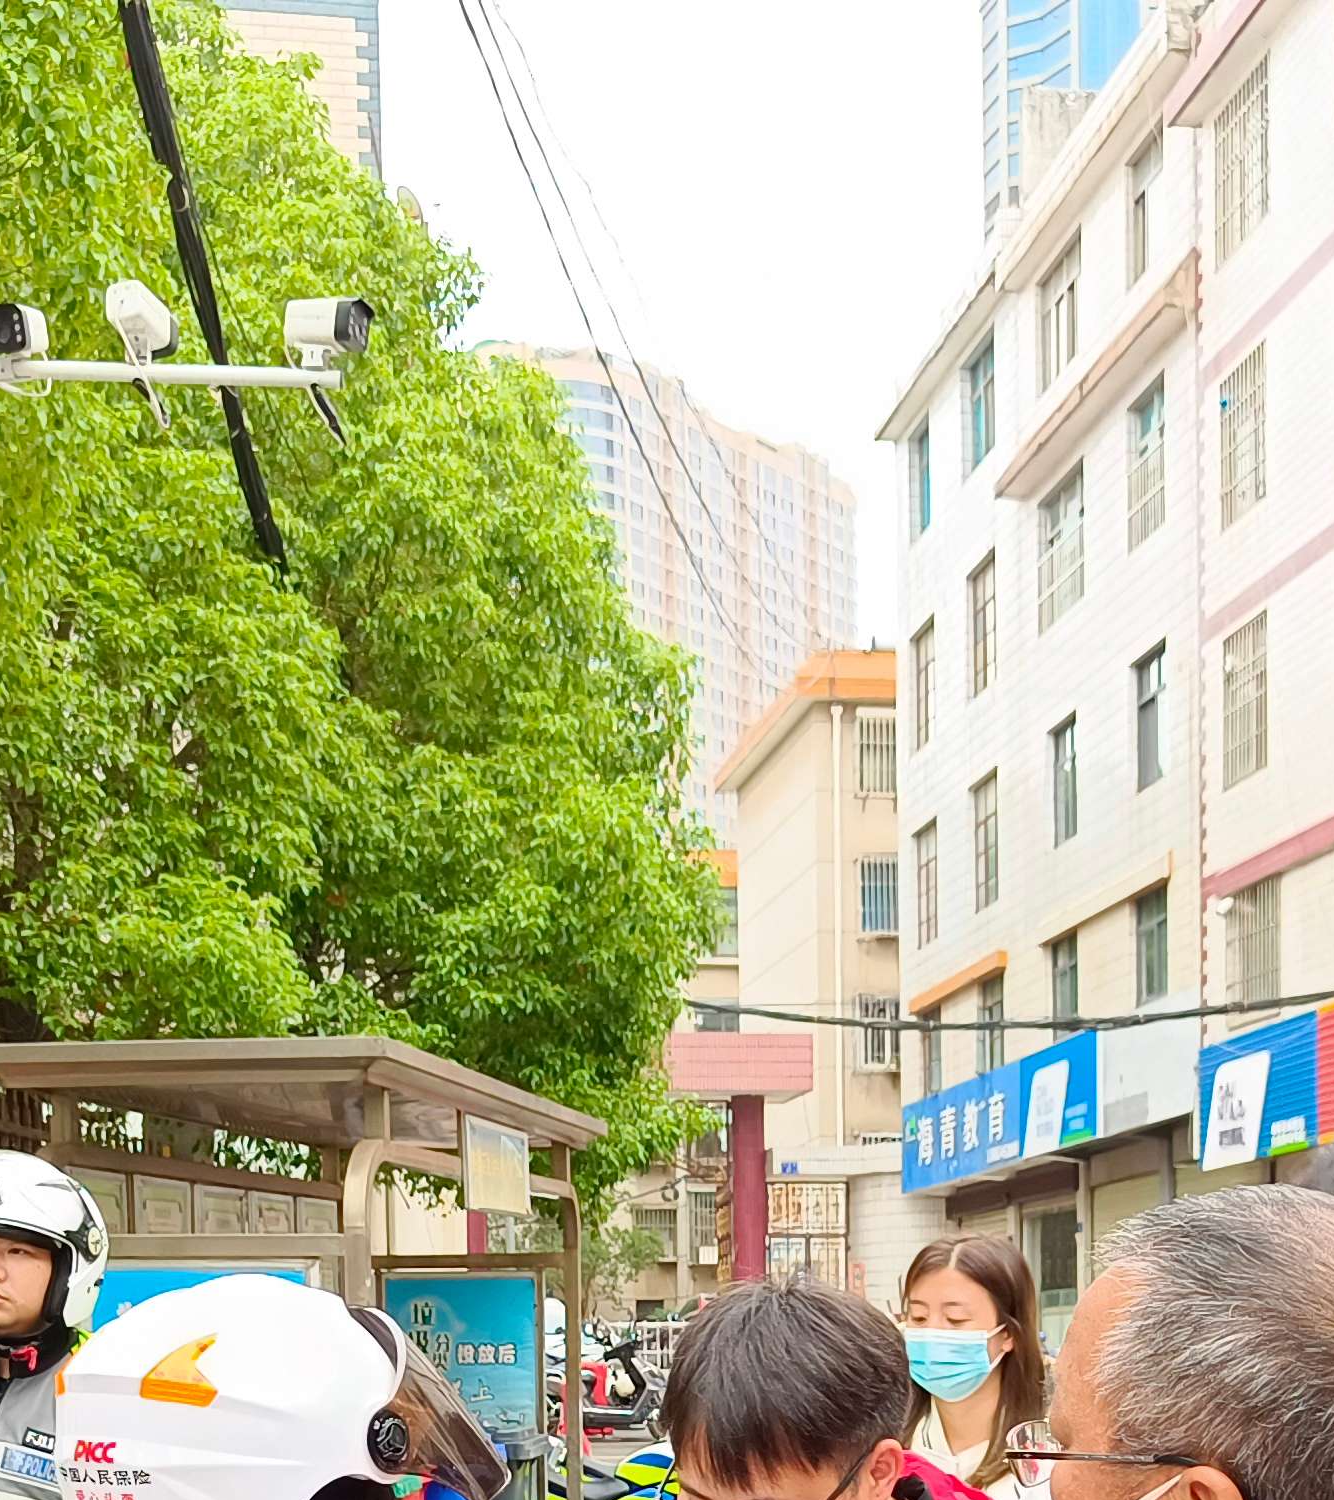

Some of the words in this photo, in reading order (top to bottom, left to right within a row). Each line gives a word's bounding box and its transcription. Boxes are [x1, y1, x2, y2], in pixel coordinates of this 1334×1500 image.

[456, 1341, 517, 1366] 投放后
[74, 1439, 117, 1464] PICC
[23, 1456, 58, 1483] POLIC
